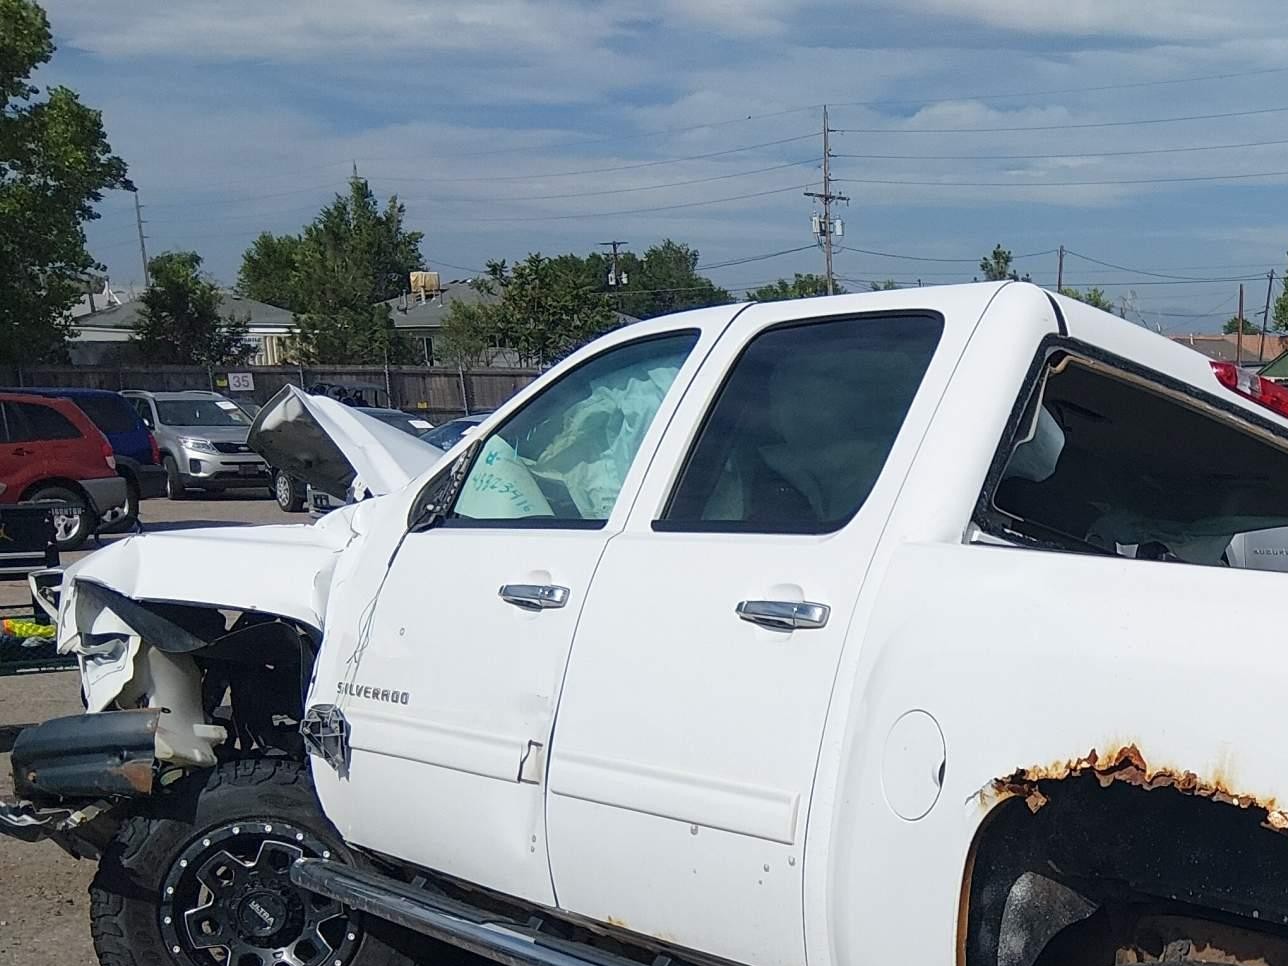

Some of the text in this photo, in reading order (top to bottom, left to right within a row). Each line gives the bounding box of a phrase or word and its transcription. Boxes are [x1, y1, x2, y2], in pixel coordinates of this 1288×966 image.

[232, 375, 250, 388] 35
[337, 681, 410, 706] SILVERADO
[249, 900, 274, 927] ULTRA
